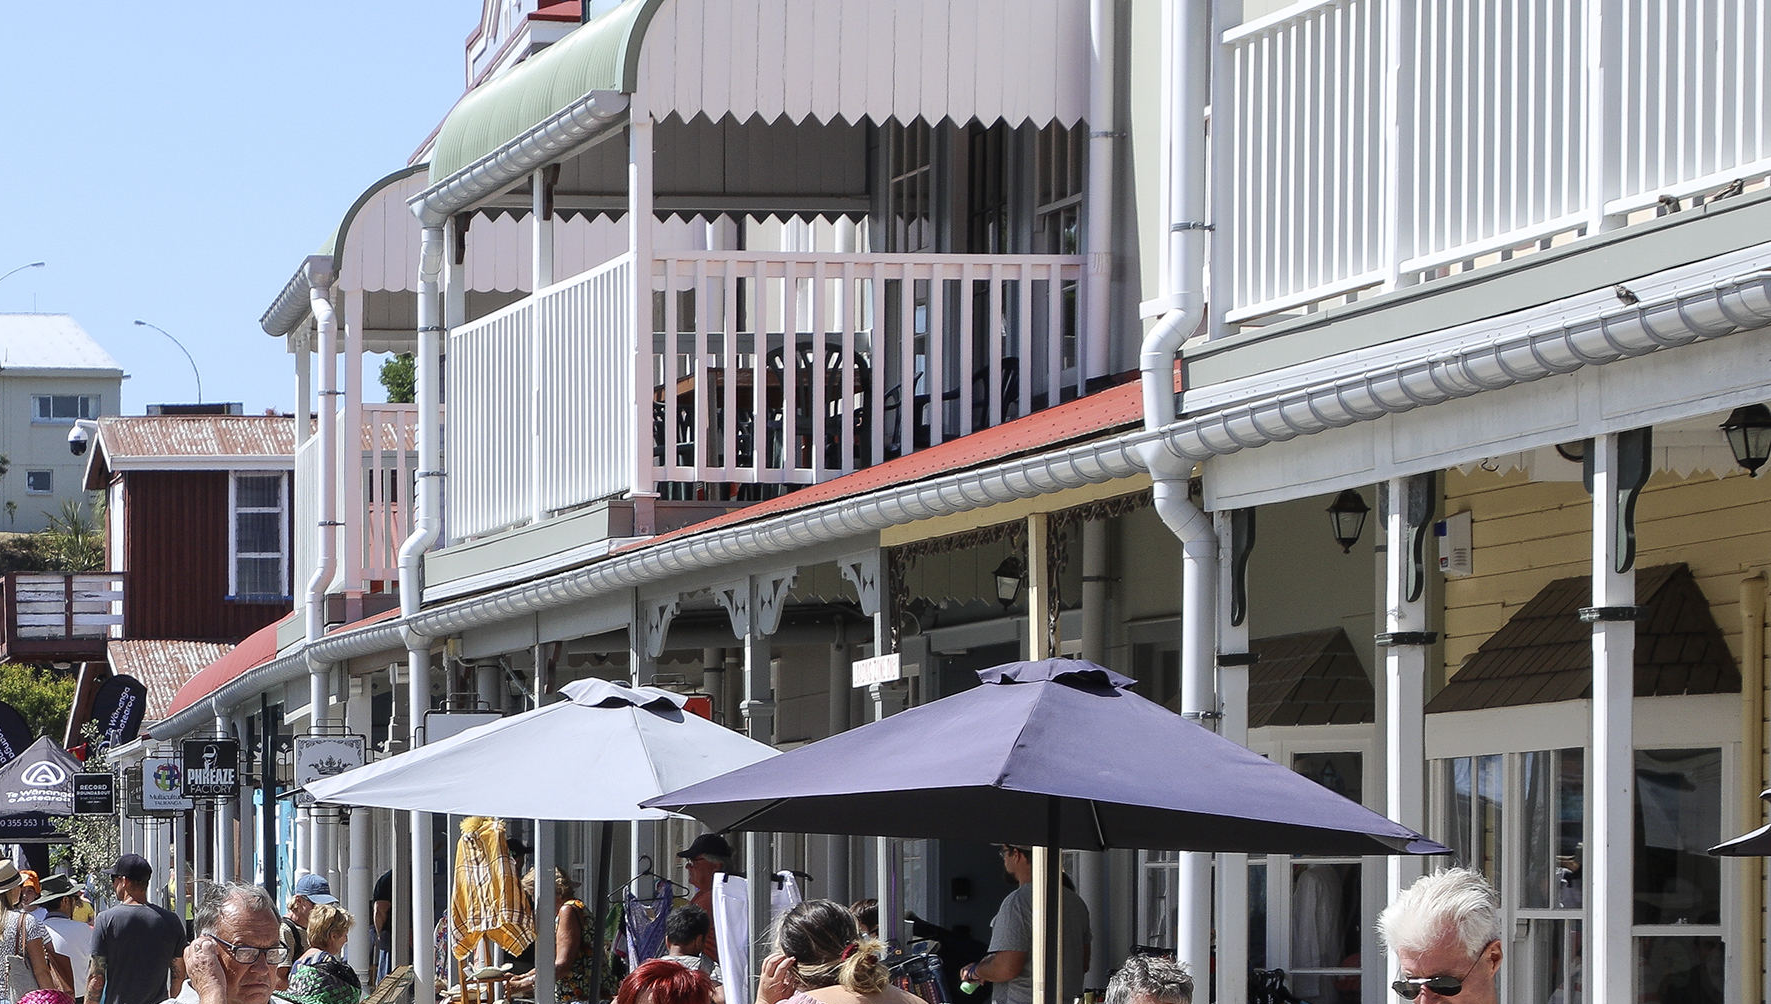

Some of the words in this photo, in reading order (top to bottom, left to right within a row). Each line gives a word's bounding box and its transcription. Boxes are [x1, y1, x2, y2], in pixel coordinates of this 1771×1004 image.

[109, 686, 131, 727] Wānanga
[187, 768, 235, 785] PHREAZE
[190, 784, 233, 794] FACTORY
[7, 819, 22, 827] 355
[23, 819, 38, 827] 553
